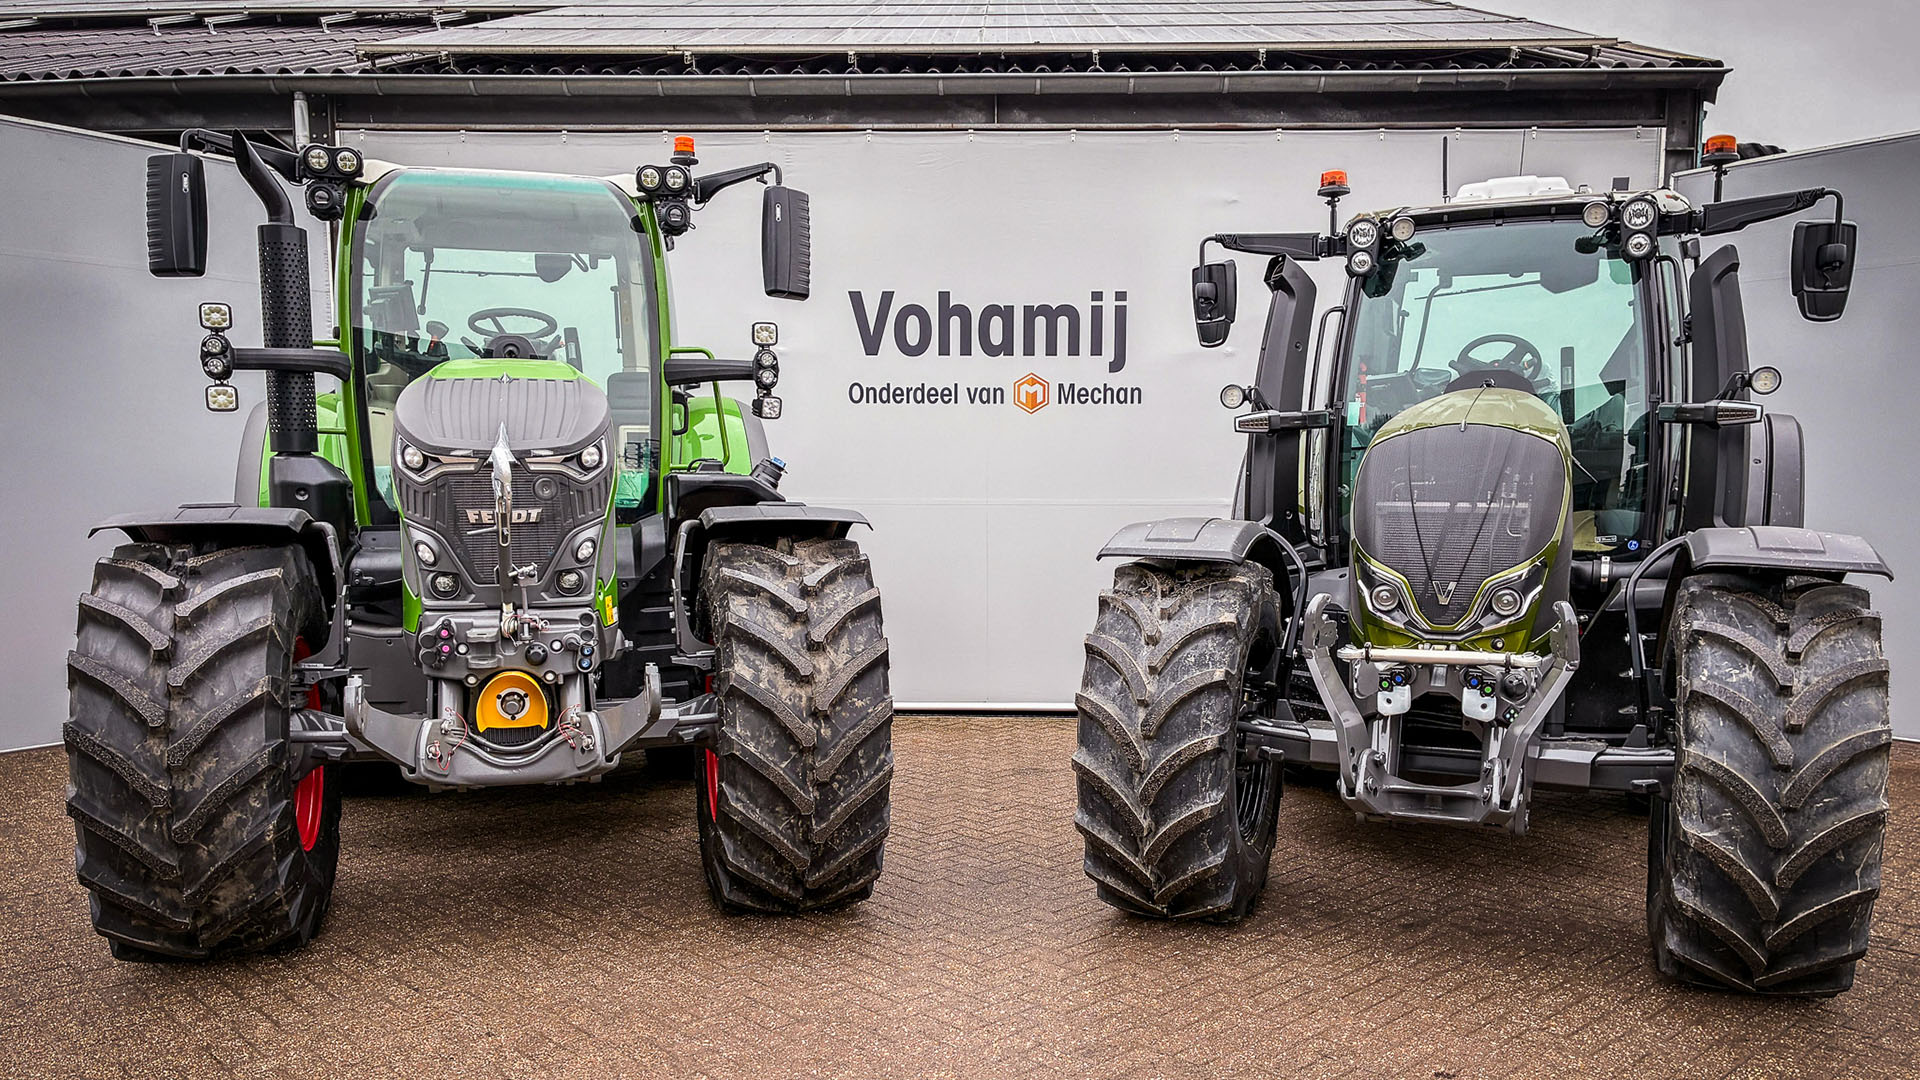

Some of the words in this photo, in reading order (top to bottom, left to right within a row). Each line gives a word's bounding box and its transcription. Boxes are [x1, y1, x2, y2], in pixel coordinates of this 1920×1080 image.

[848, 290, 1128, 373] Vohamij
[848, 382, 959, 405] Onderdeel
[966, 386, 1005, 405] van
[1057, 382, 1142, 405] Mechan
[465, 508, 542, 524] FEDT
